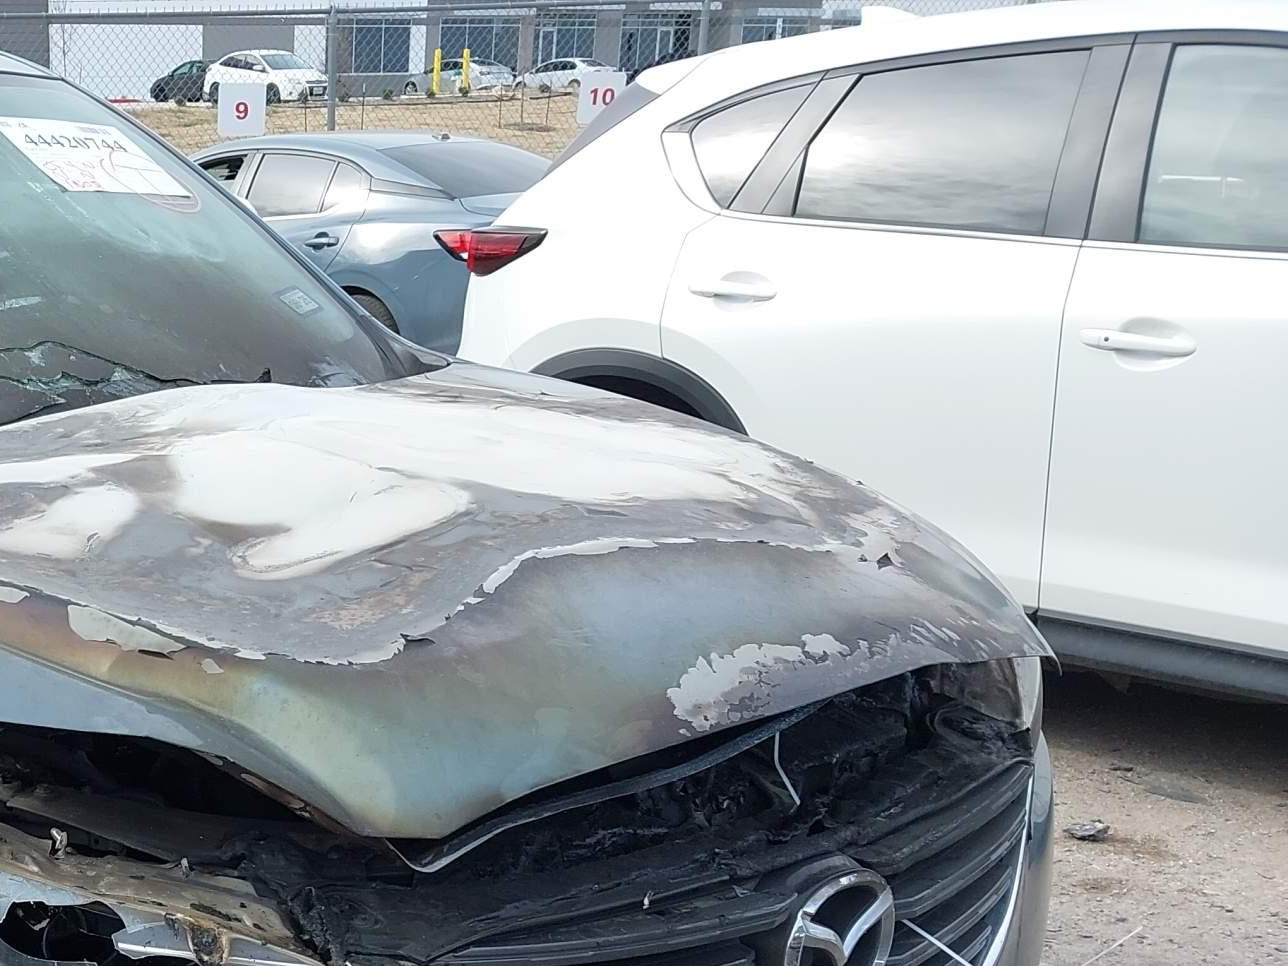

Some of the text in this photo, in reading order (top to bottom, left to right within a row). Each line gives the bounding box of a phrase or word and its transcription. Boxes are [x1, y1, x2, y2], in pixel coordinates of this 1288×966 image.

[590, 88, 615, 106] 10
[235, 102, 249, 121] 9
[24, 133, 129, 153] 44420744
